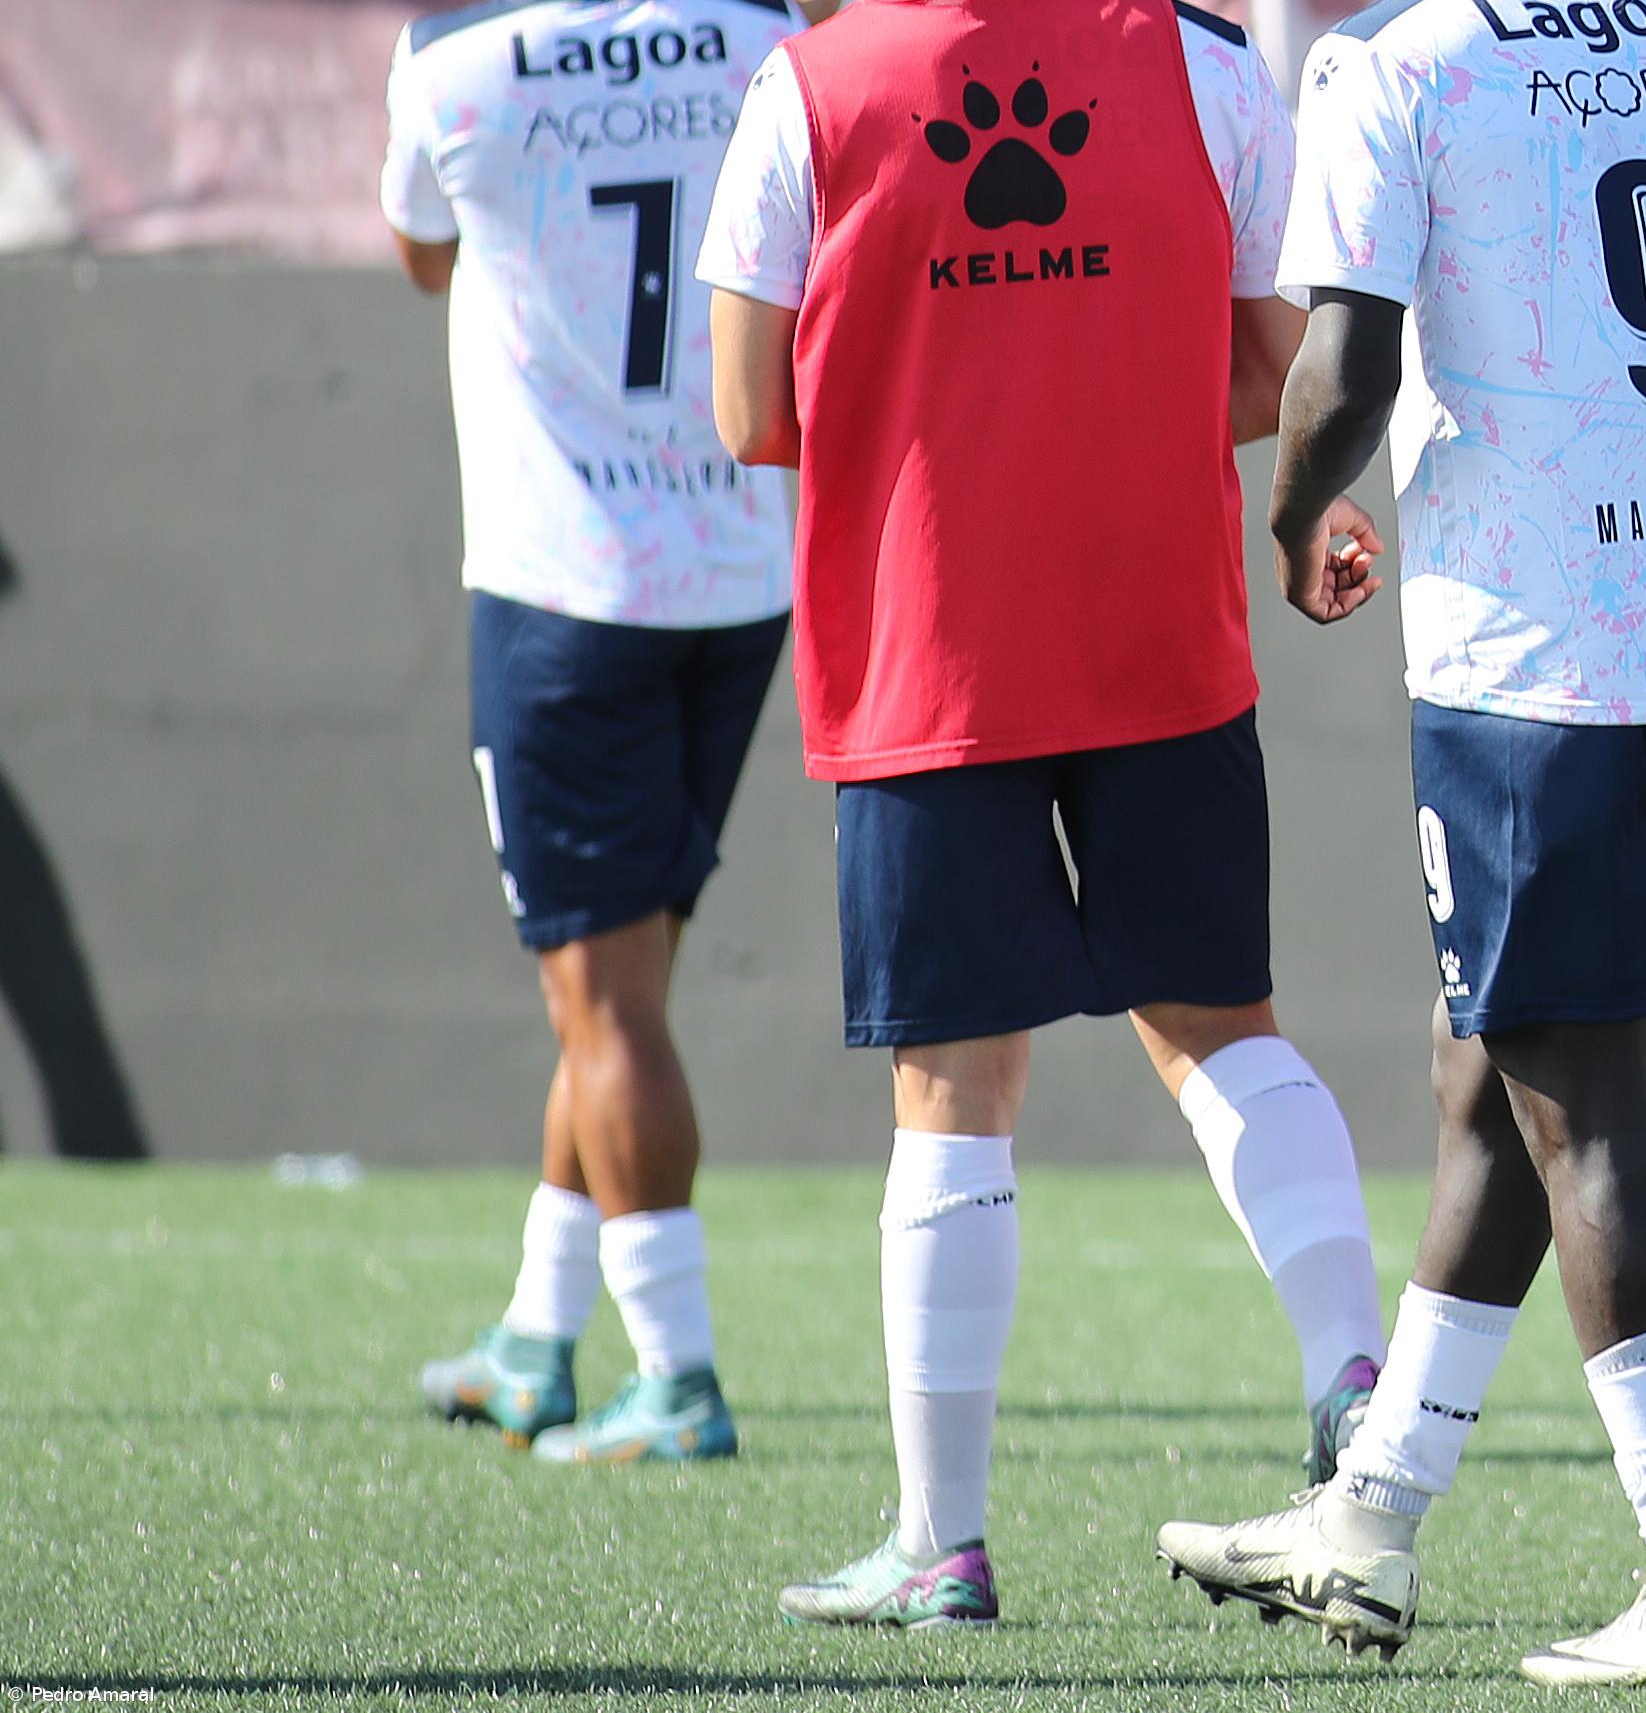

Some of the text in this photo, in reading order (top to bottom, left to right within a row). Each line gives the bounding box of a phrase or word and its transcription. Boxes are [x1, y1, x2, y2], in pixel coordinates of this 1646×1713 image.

[511, 22, 727, 86] Lagoa
[929, 244, 1112, 290] KELME
[1418, 805, 1455, 925] 9
